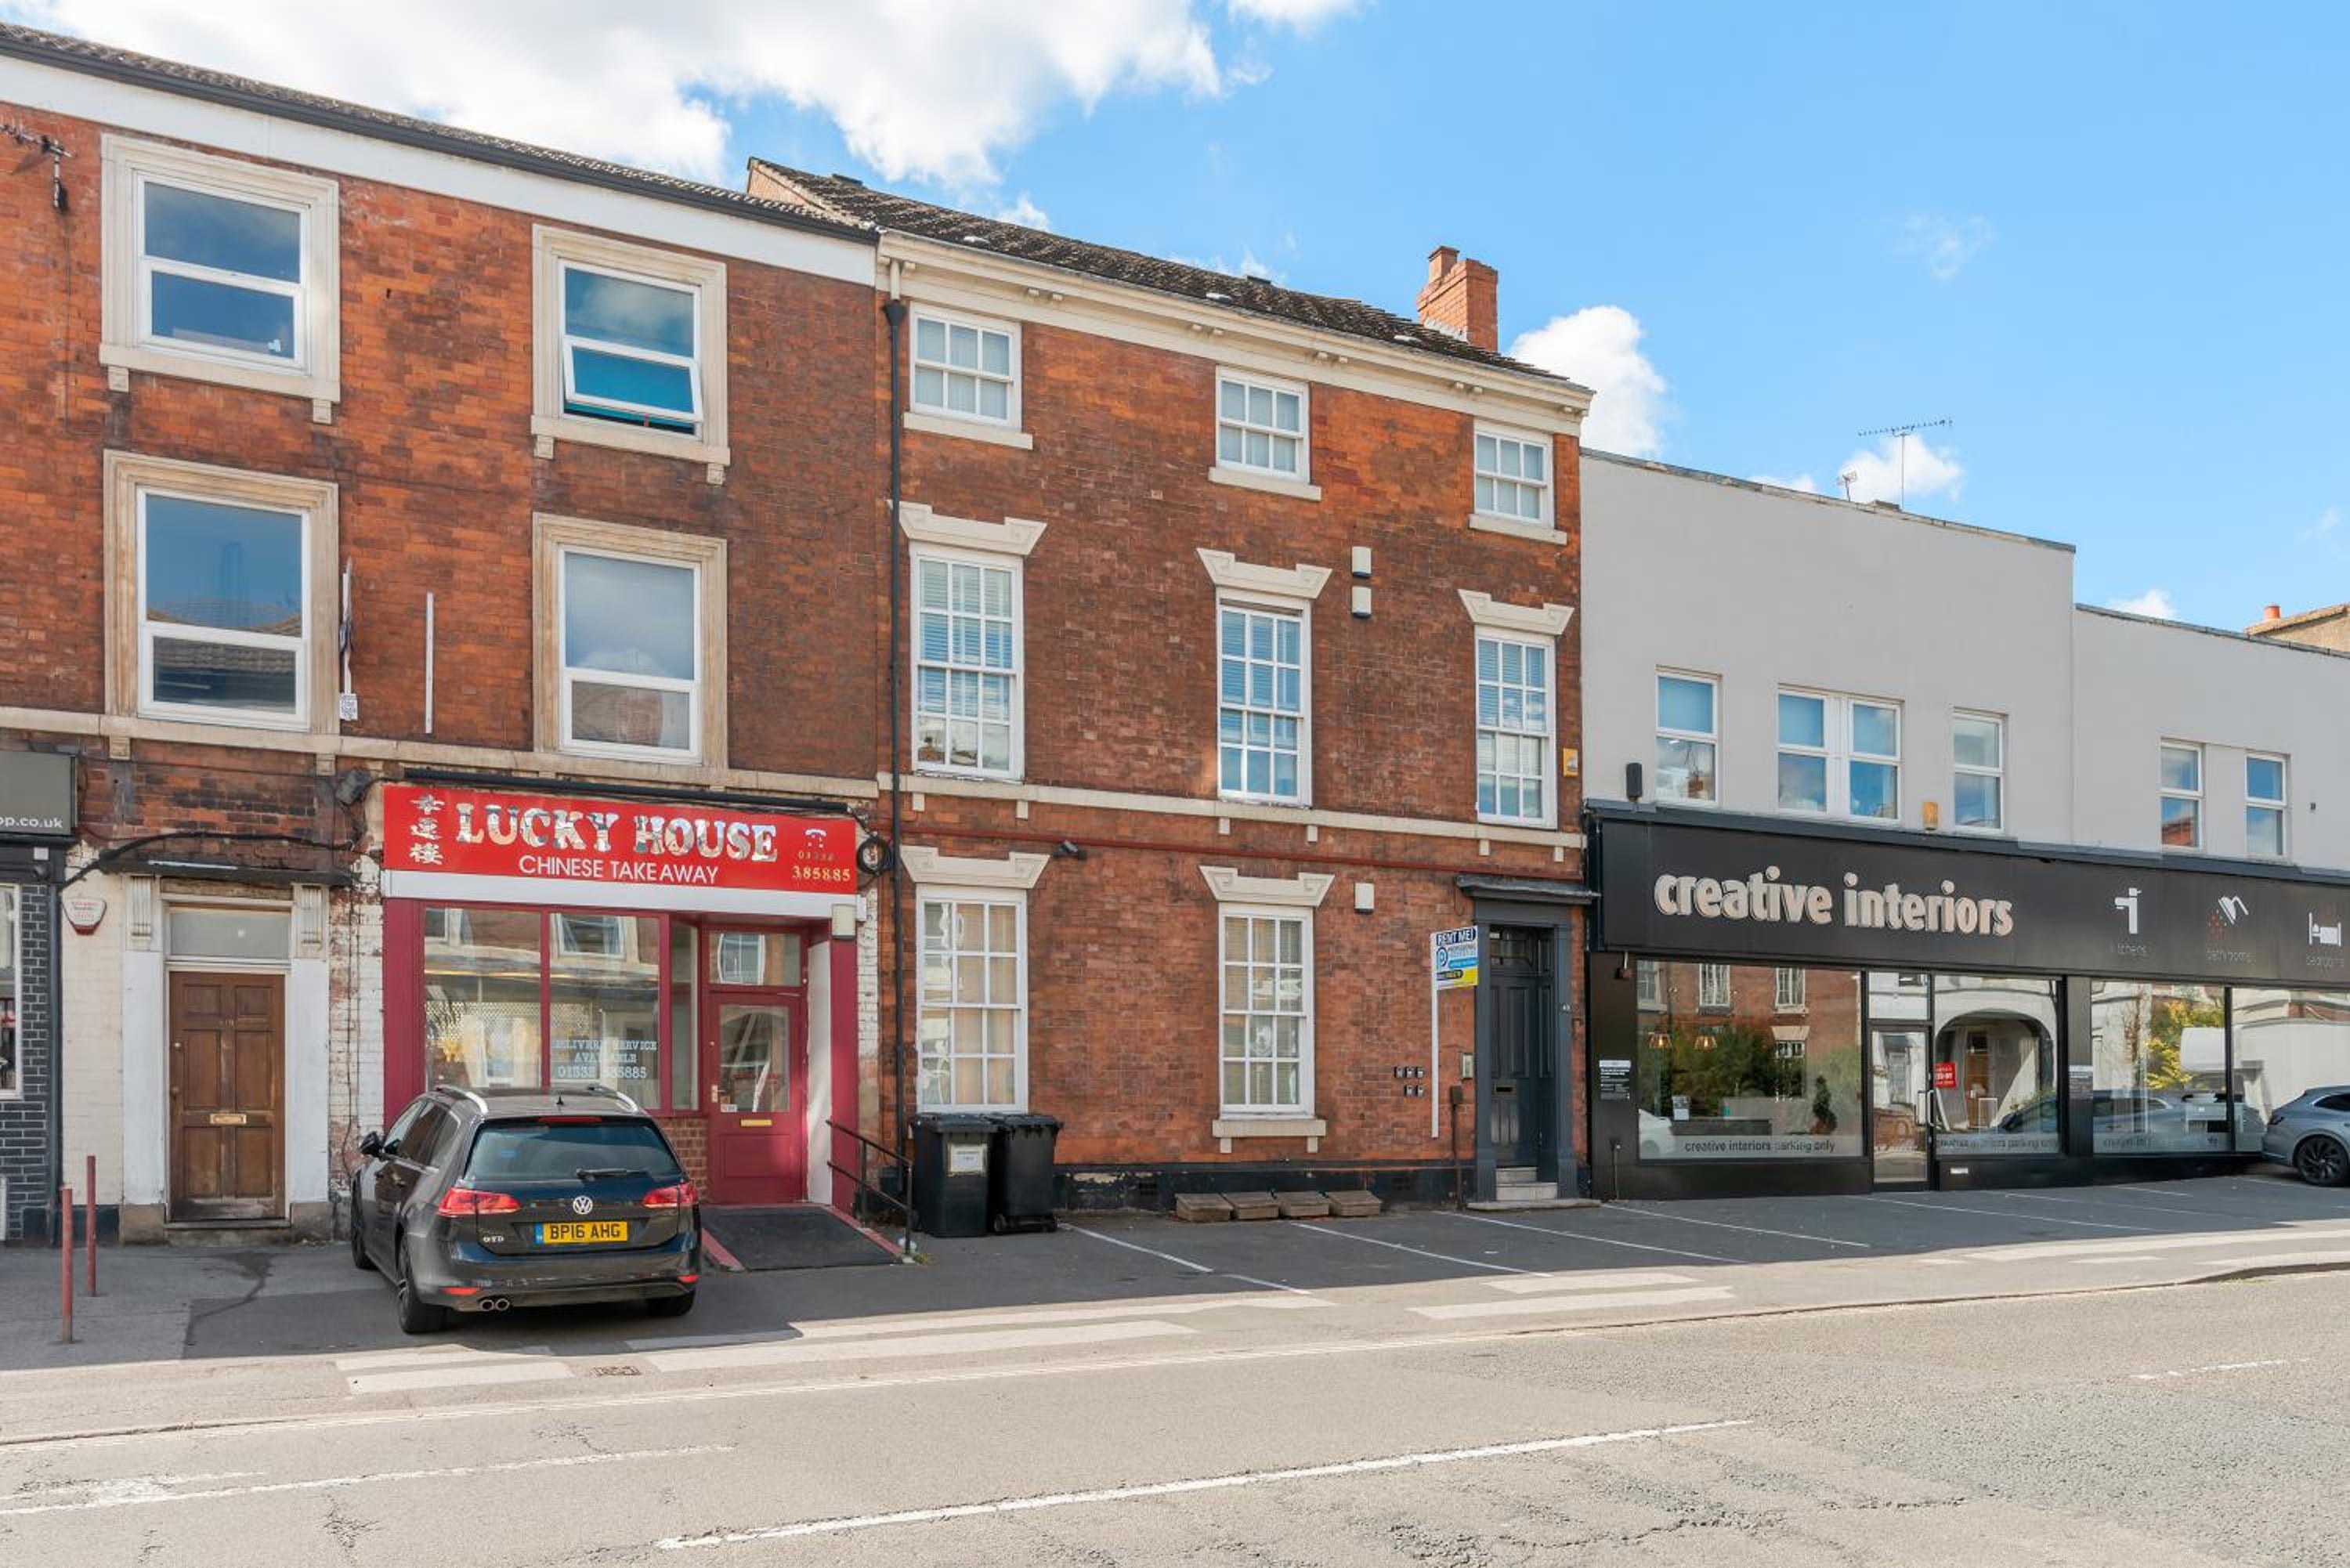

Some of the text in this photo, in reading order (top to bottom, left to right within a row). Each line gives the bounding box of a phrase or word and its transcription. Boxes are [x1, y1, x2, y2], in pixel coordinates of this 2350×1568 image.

[456, 803, 778, 862] LUCKY HOUSE
[519, 855, 603, 878] CHINESE
[792, 865, 850, 881] 385885
[1654, 865, 2013, 936] creative interiors
[1685, 1140, 1726, 1152] creative
[1729, 1140, 1771, 1151] interiors
[1814, 1140, 1835, 1153] only
[550, 1224, 585, 1240] BP16
[590, 1223, 620, 1238] AHG
